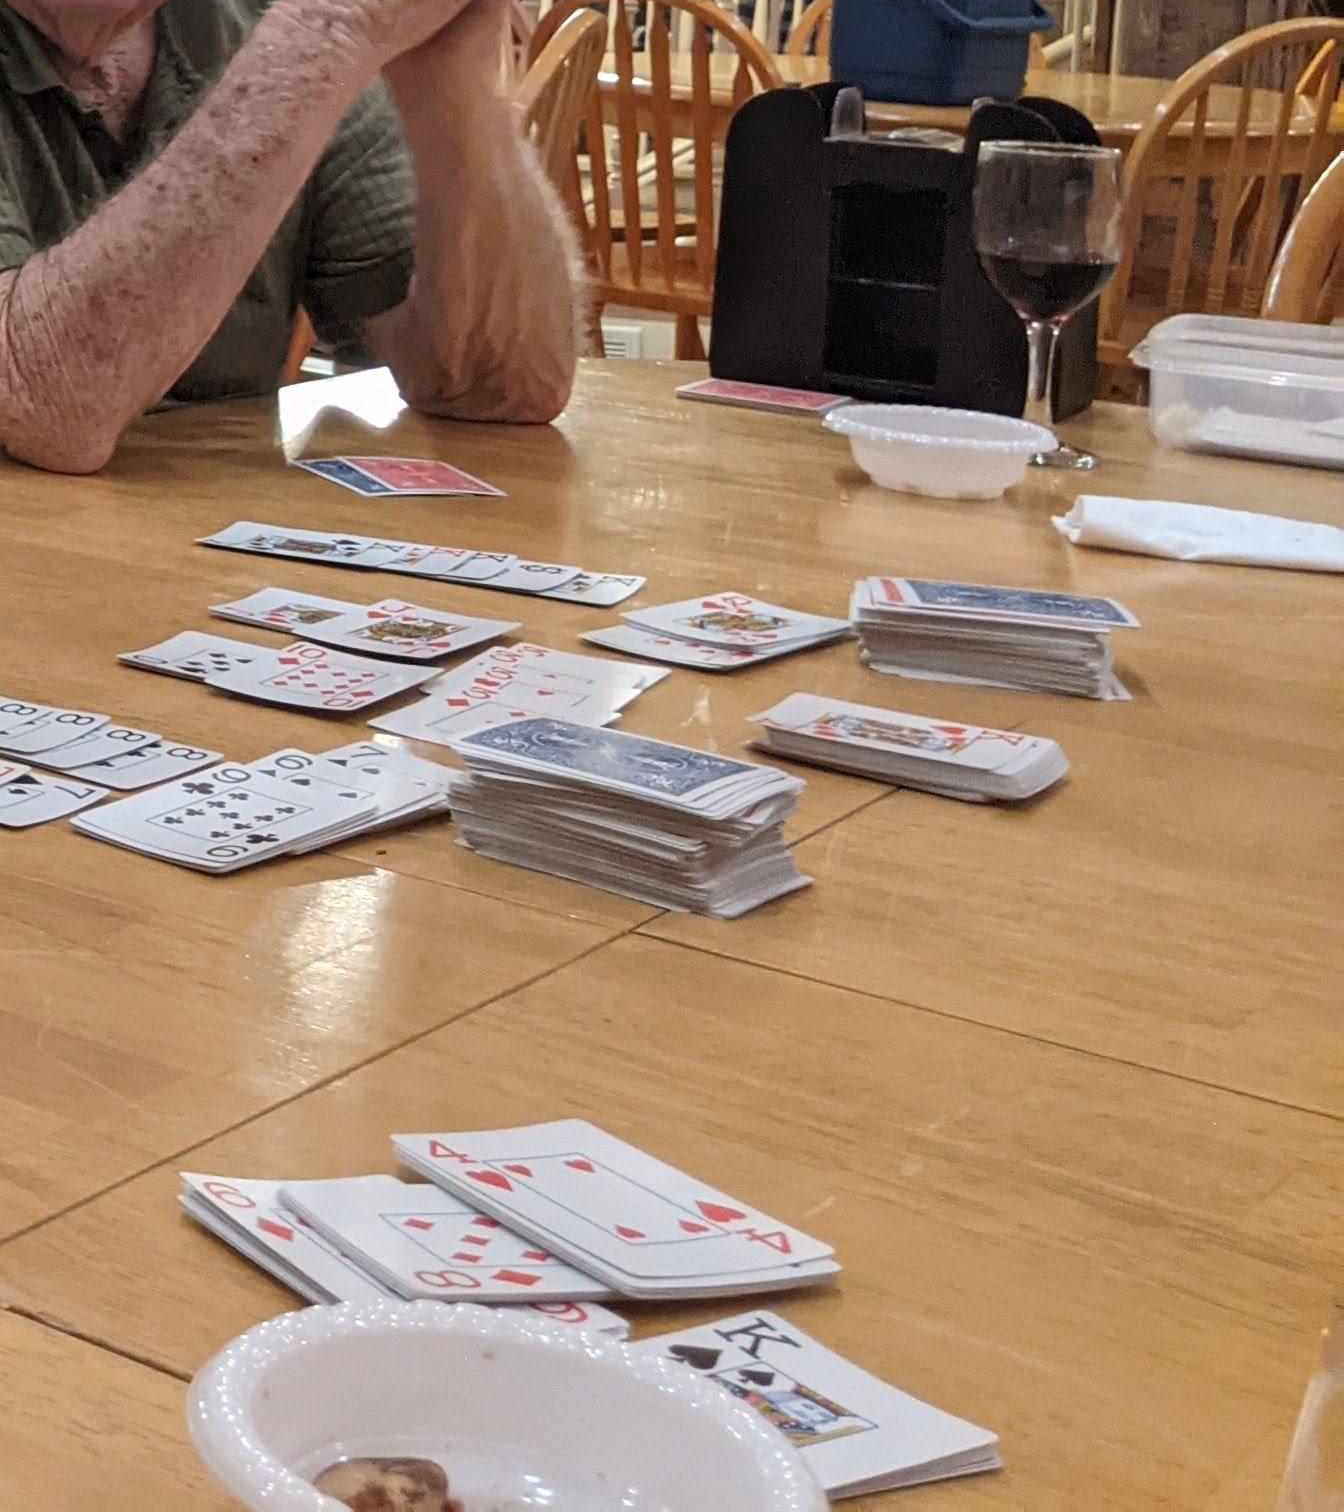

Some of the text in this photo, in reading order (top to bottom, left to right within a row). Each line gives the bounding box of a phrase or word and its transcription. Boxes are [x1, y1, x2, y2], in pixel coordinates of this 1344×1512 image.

[288, 644, 327, 659] 10
[0, 703, 37, 715] 8
[56, 713, 95, 725] 8
[106, 729, 145, 742] 8
[166, 747, 208, 760] 8
[54, 785, 96, 799] 7
[427, 1139, 477, 1165] 4
[202, 1182, 256, 1208] 6
[735, 1228, 792, 1255] 4
[414, 1270, 482, 1288] 8
[713, 1317, 802, 1360] K
